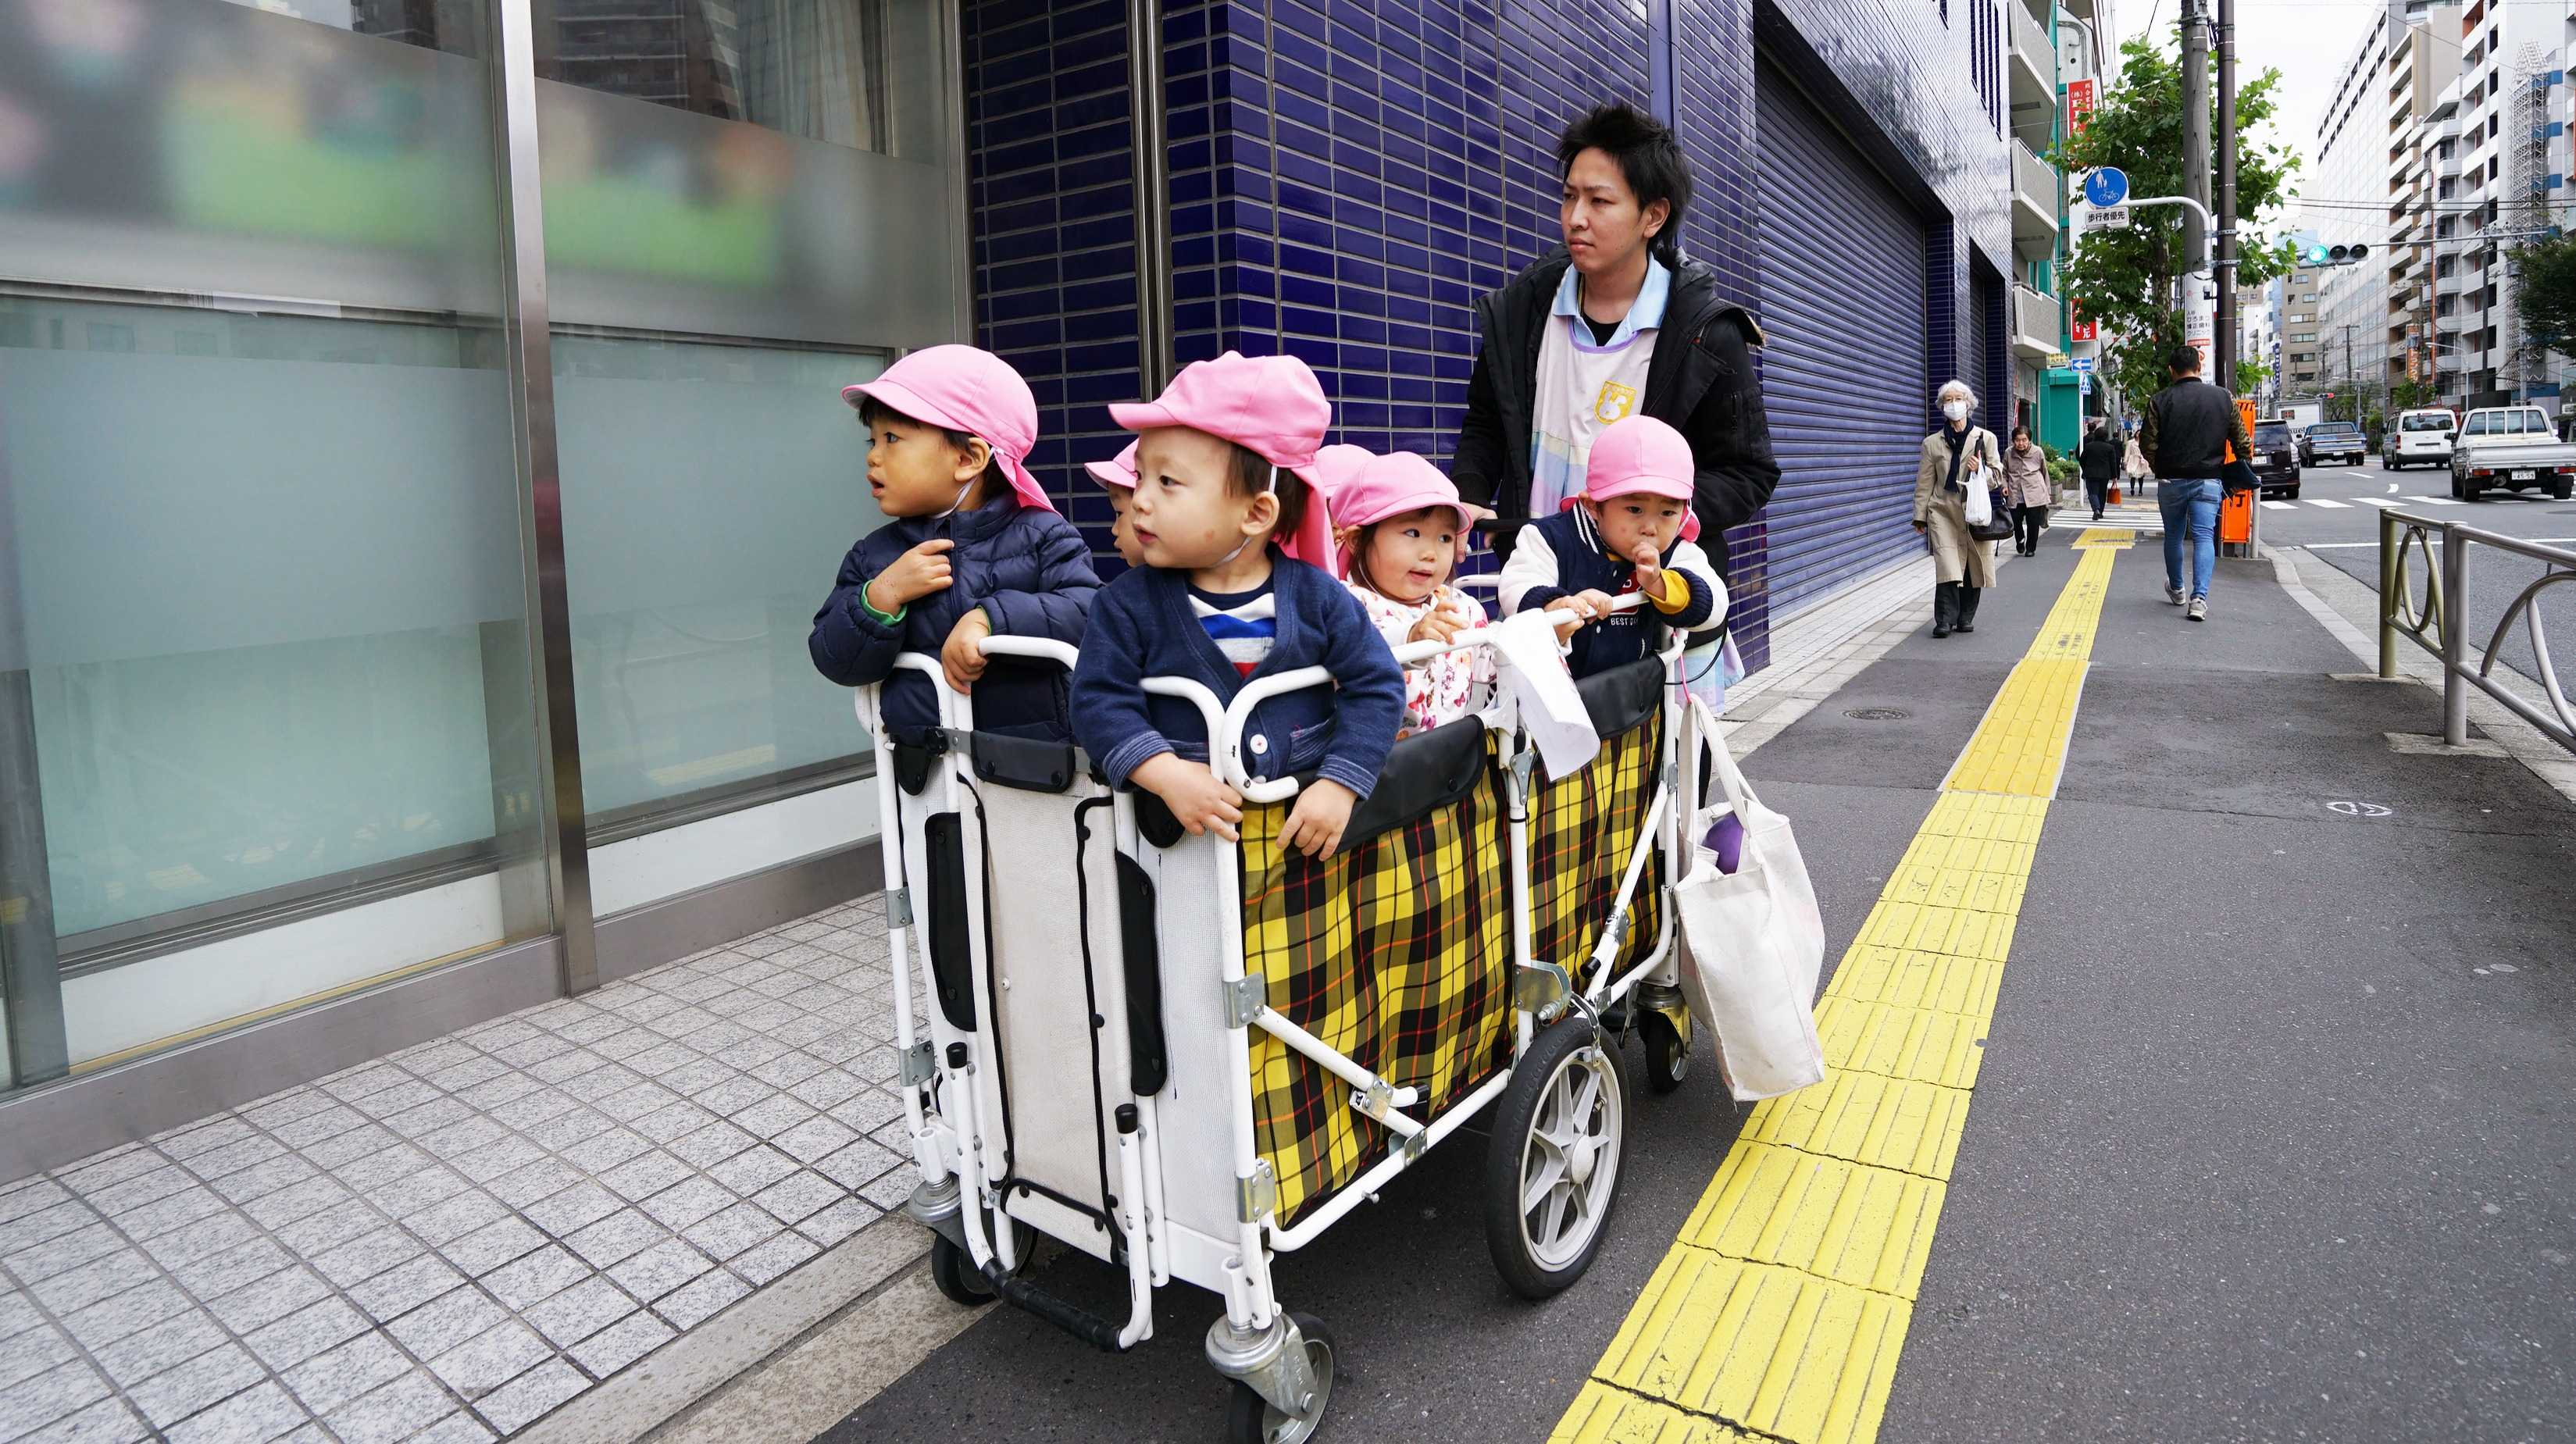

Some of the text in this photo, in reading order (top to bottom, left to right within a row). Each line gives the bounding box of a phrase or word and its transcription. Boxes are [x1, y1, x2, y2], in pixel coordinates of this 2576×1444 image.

[2088, 211, 2125, 223] 歩行者優先
[1611, 617, 1629, 626] BEST
